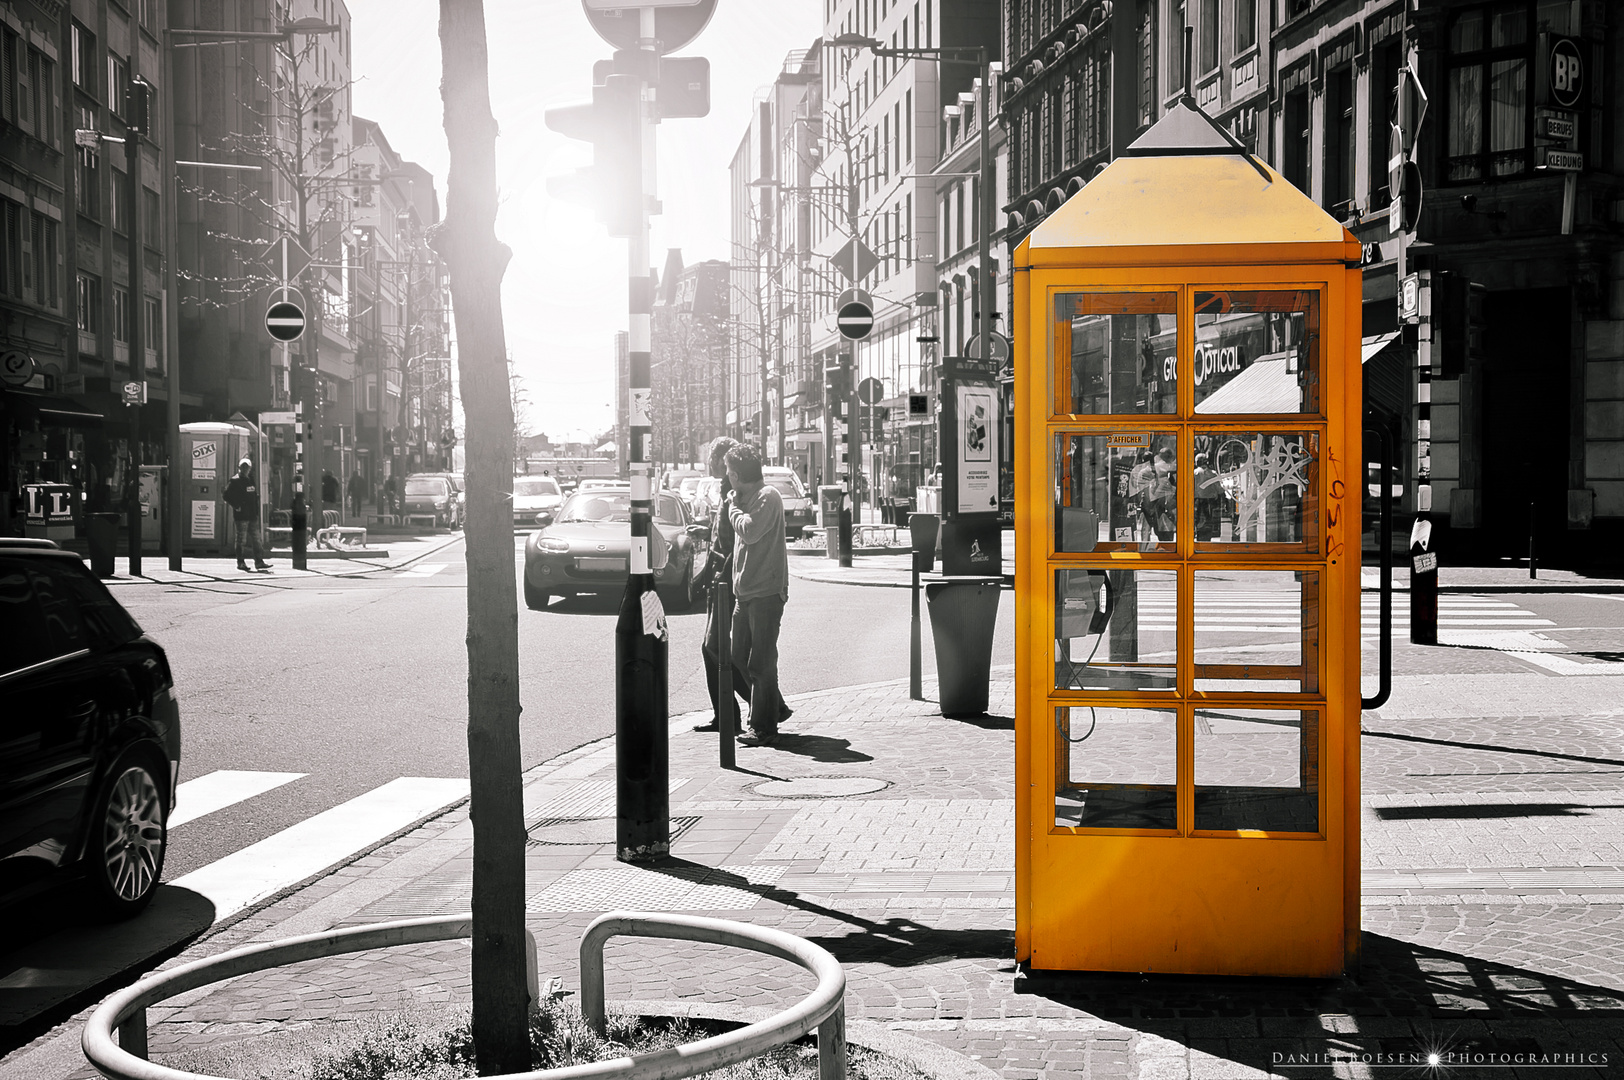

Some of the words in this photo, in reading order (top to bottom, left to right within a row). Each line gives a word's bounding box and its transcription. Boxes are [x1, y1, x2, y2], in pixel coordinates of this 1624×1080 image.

[1555, 53, 1579, 92] BP
[1548, 121, 1573, 136] BERUFS
[1548, 154, 1582, 168] KLEIDUNG
[193, 444, 216, 458] DIXI
